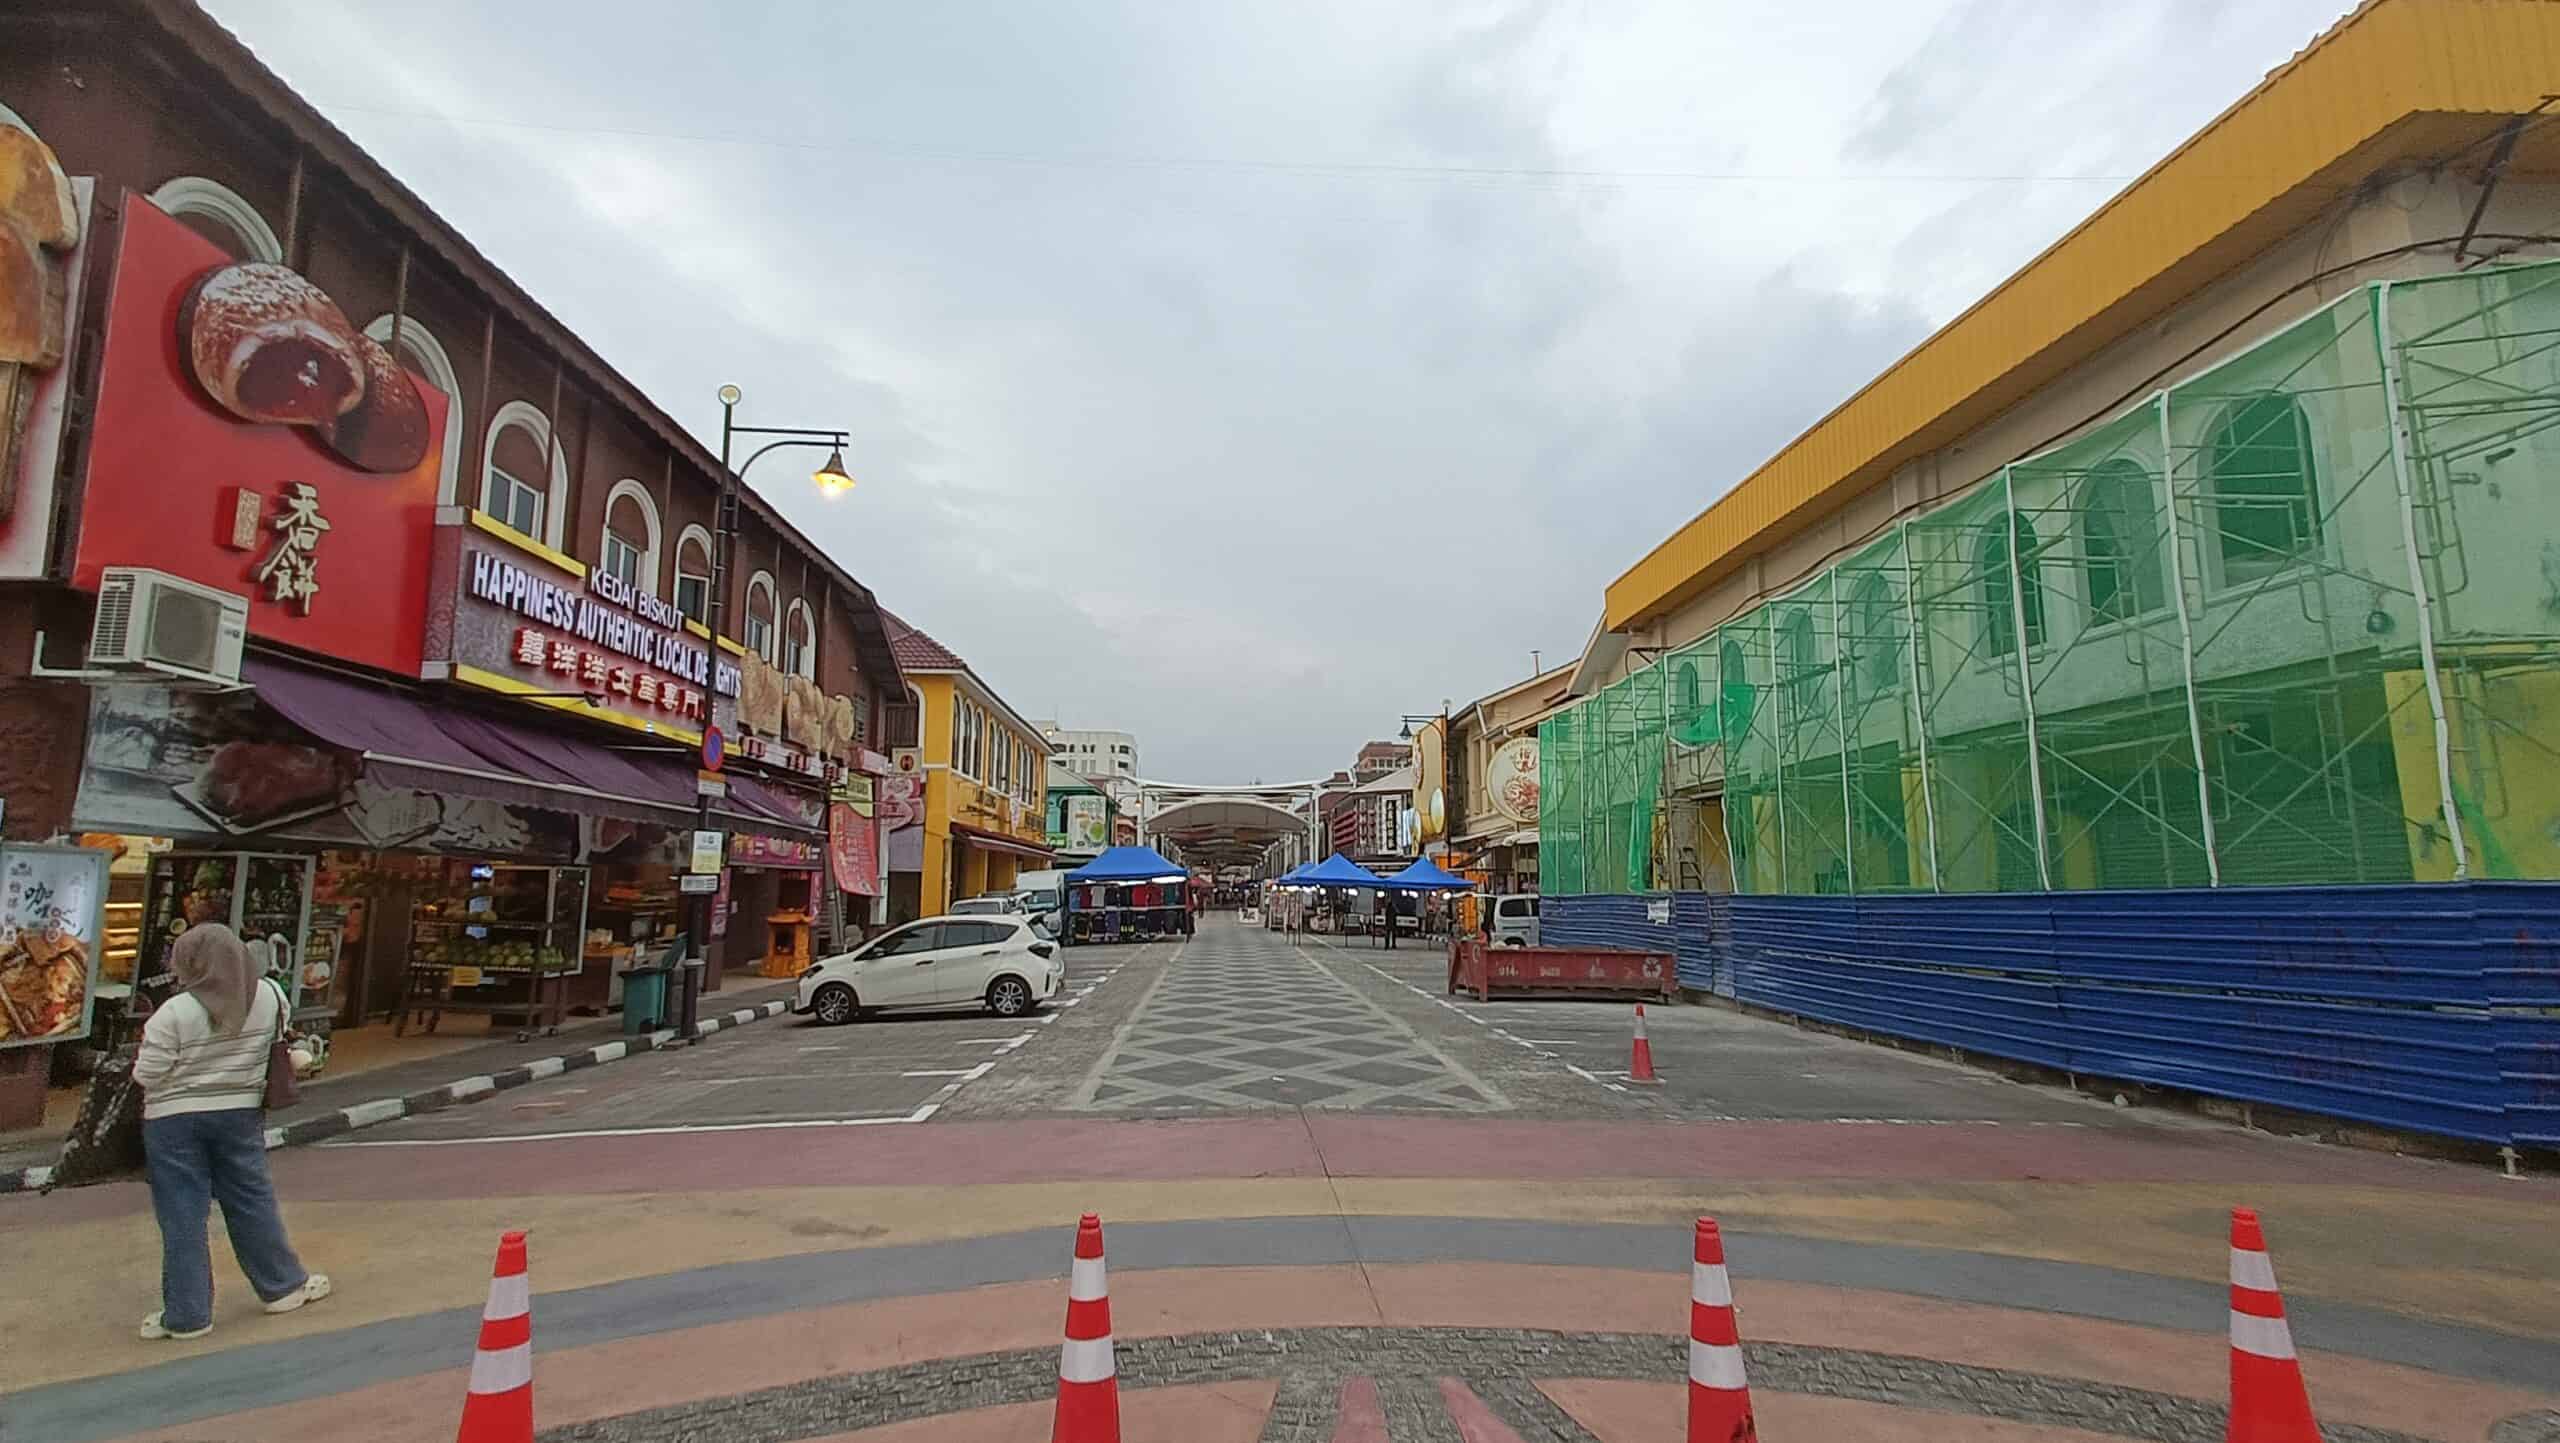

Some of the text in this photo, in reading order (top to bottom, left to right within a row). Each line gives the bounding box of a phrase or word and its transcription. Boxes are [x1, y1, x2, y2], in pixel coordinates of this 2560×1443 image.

[260, 482, 332, 615] 香餅
[590, 566, 686, 634] KEDAI BISKUT
[473, 551, 742, 700] HAPPINESS AUTHENTIC LOCAL DEGHTS
